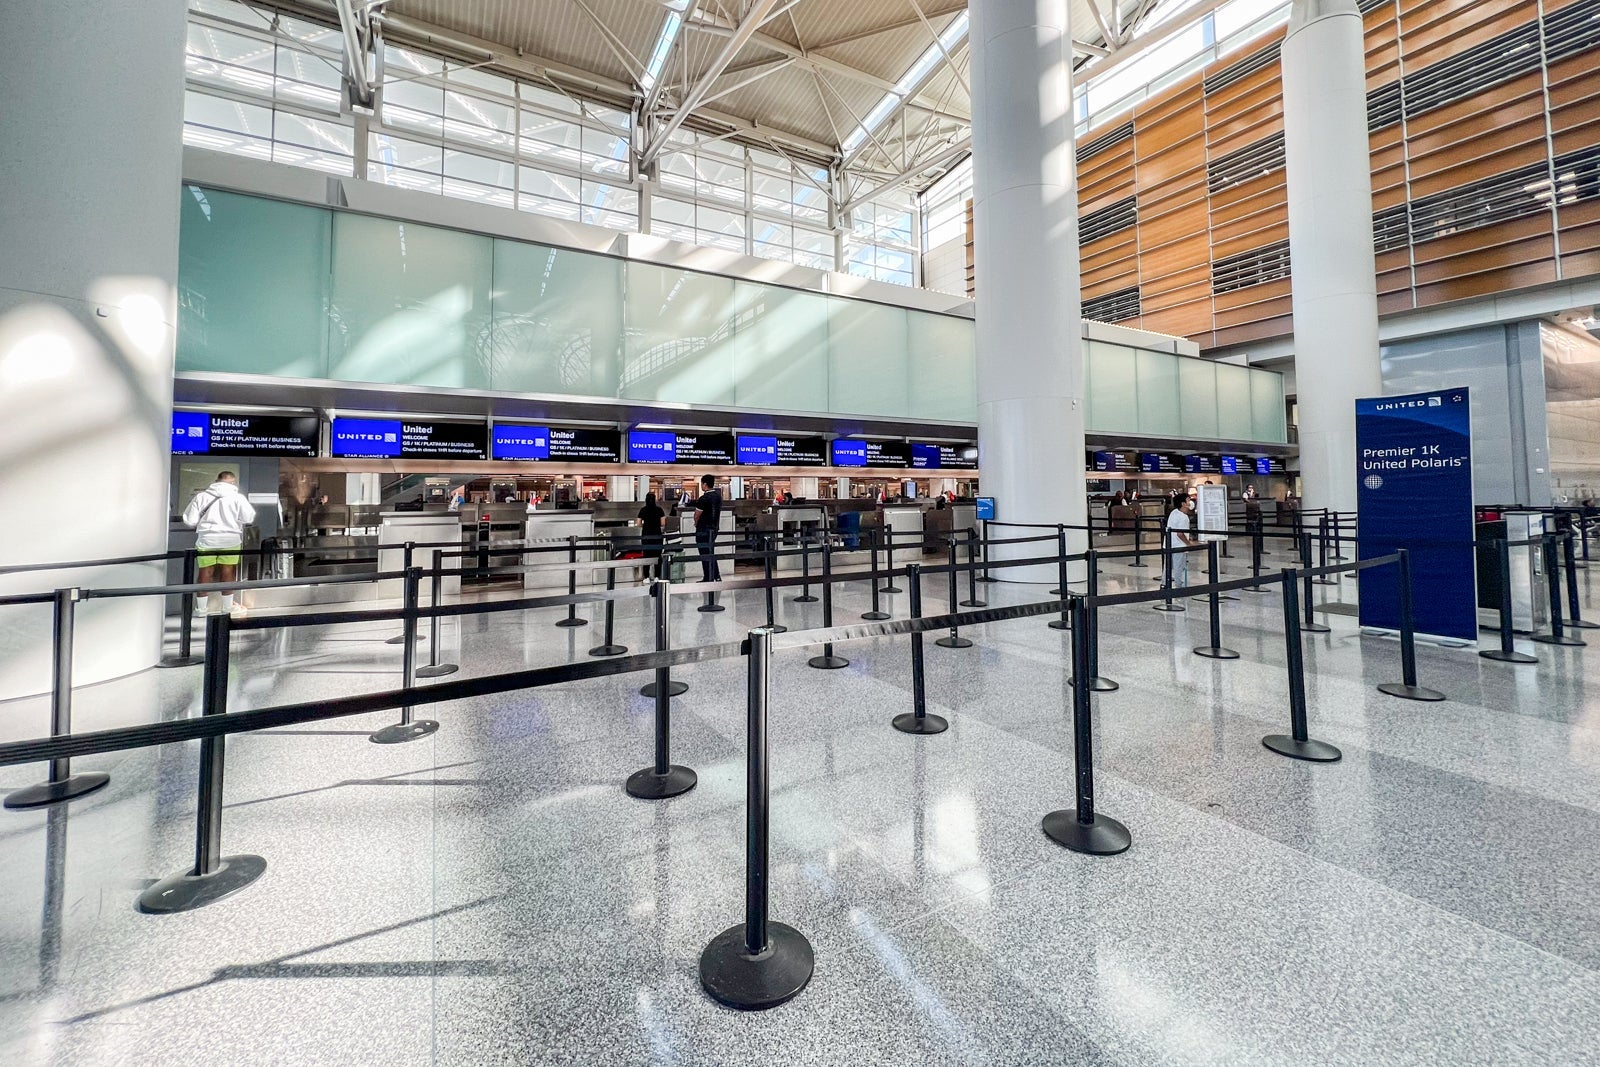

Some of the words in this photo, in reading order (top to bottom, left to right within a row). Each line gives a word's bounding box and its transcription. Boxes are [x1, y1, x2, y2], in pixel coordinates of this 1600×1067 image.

[1376, 400, 1426, 410] UNITED
[211, 418, 249, 428] United
[402, 425, 433, 434] United
[337, 433, 383, 441] UNITED
[550, 431, 575, 439] United
[1363, 446, 1416, 458] Premier
[1421, 444, 1440, 455] 1K
[1363, 459, 1407, 470] United
